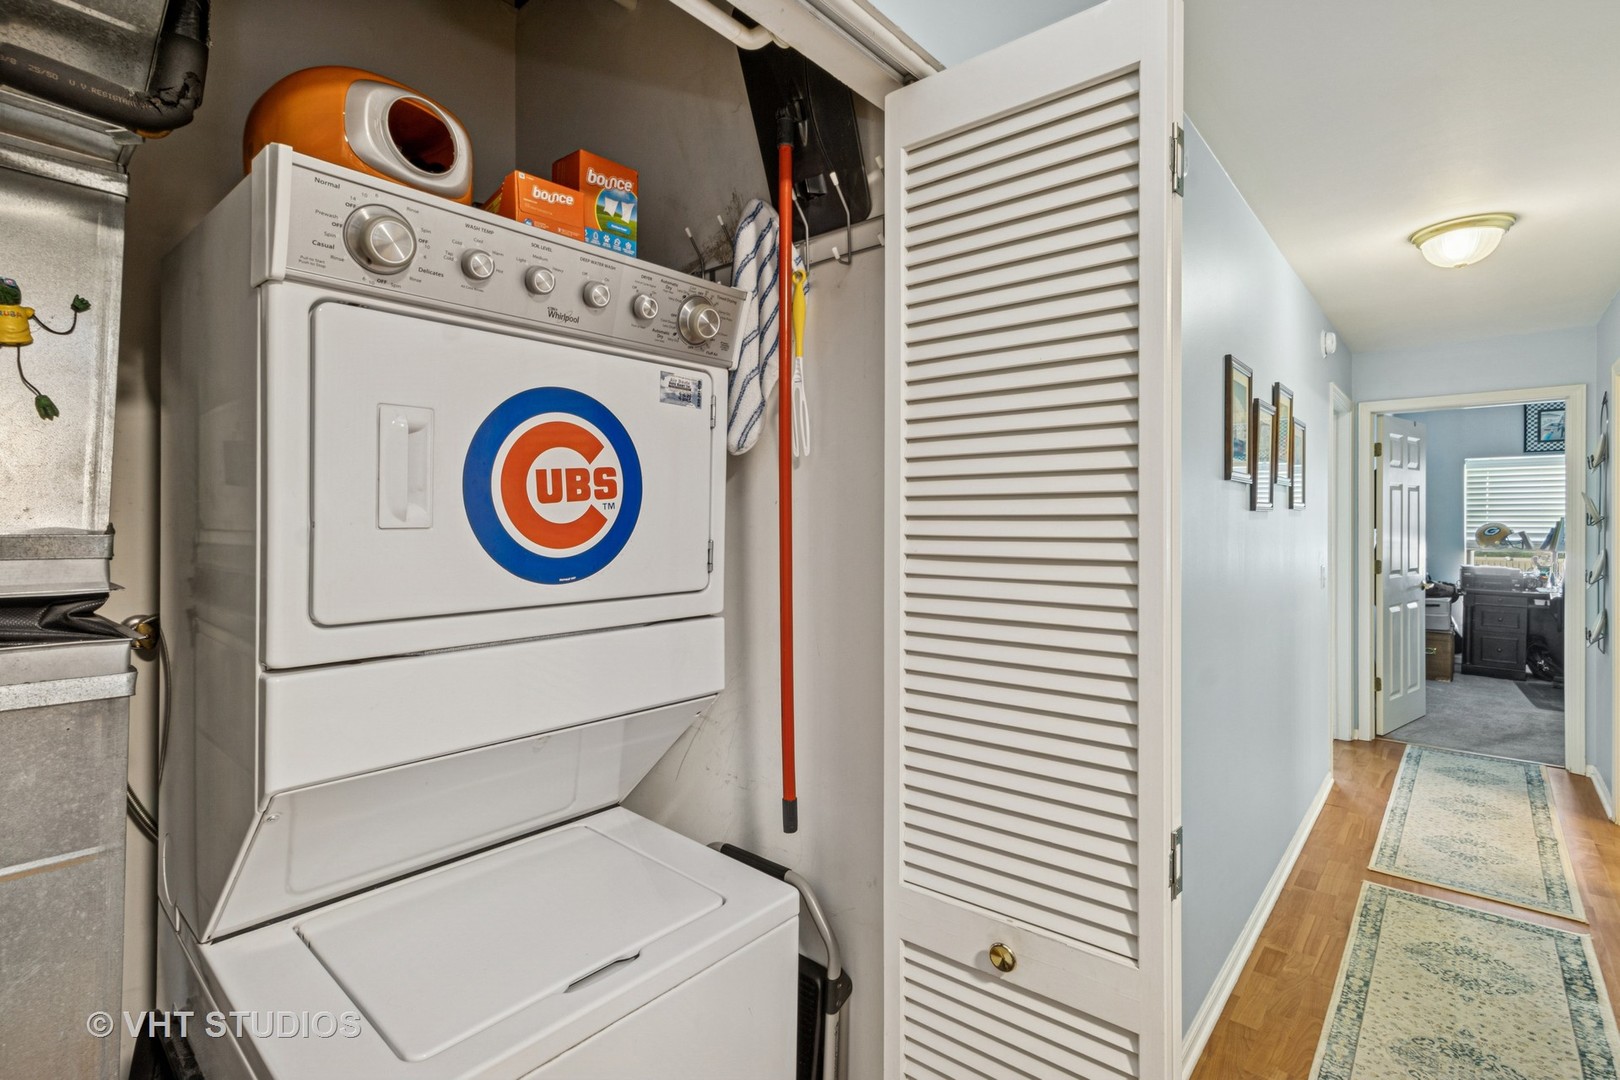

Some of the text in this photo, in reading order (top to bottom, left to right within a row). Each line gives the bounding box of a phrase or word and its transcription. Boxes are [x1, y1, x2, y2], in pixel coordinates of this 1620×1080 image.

[314, 177, 341, 189] Normal
[587, 167, 634, 193] bounce
[532, 185, 574, 206] bounce
[315, 209, 339, 219] Prewash
[465, 223, 480, 231] WASH
[324, 231, 337, 239] Spin
[312, 239, 335, 250] Casual
[418, 267, 444, 278] Delicates
[547, 310, 580, 324] Whirlpool
[602, 502, 616, 511] TM
